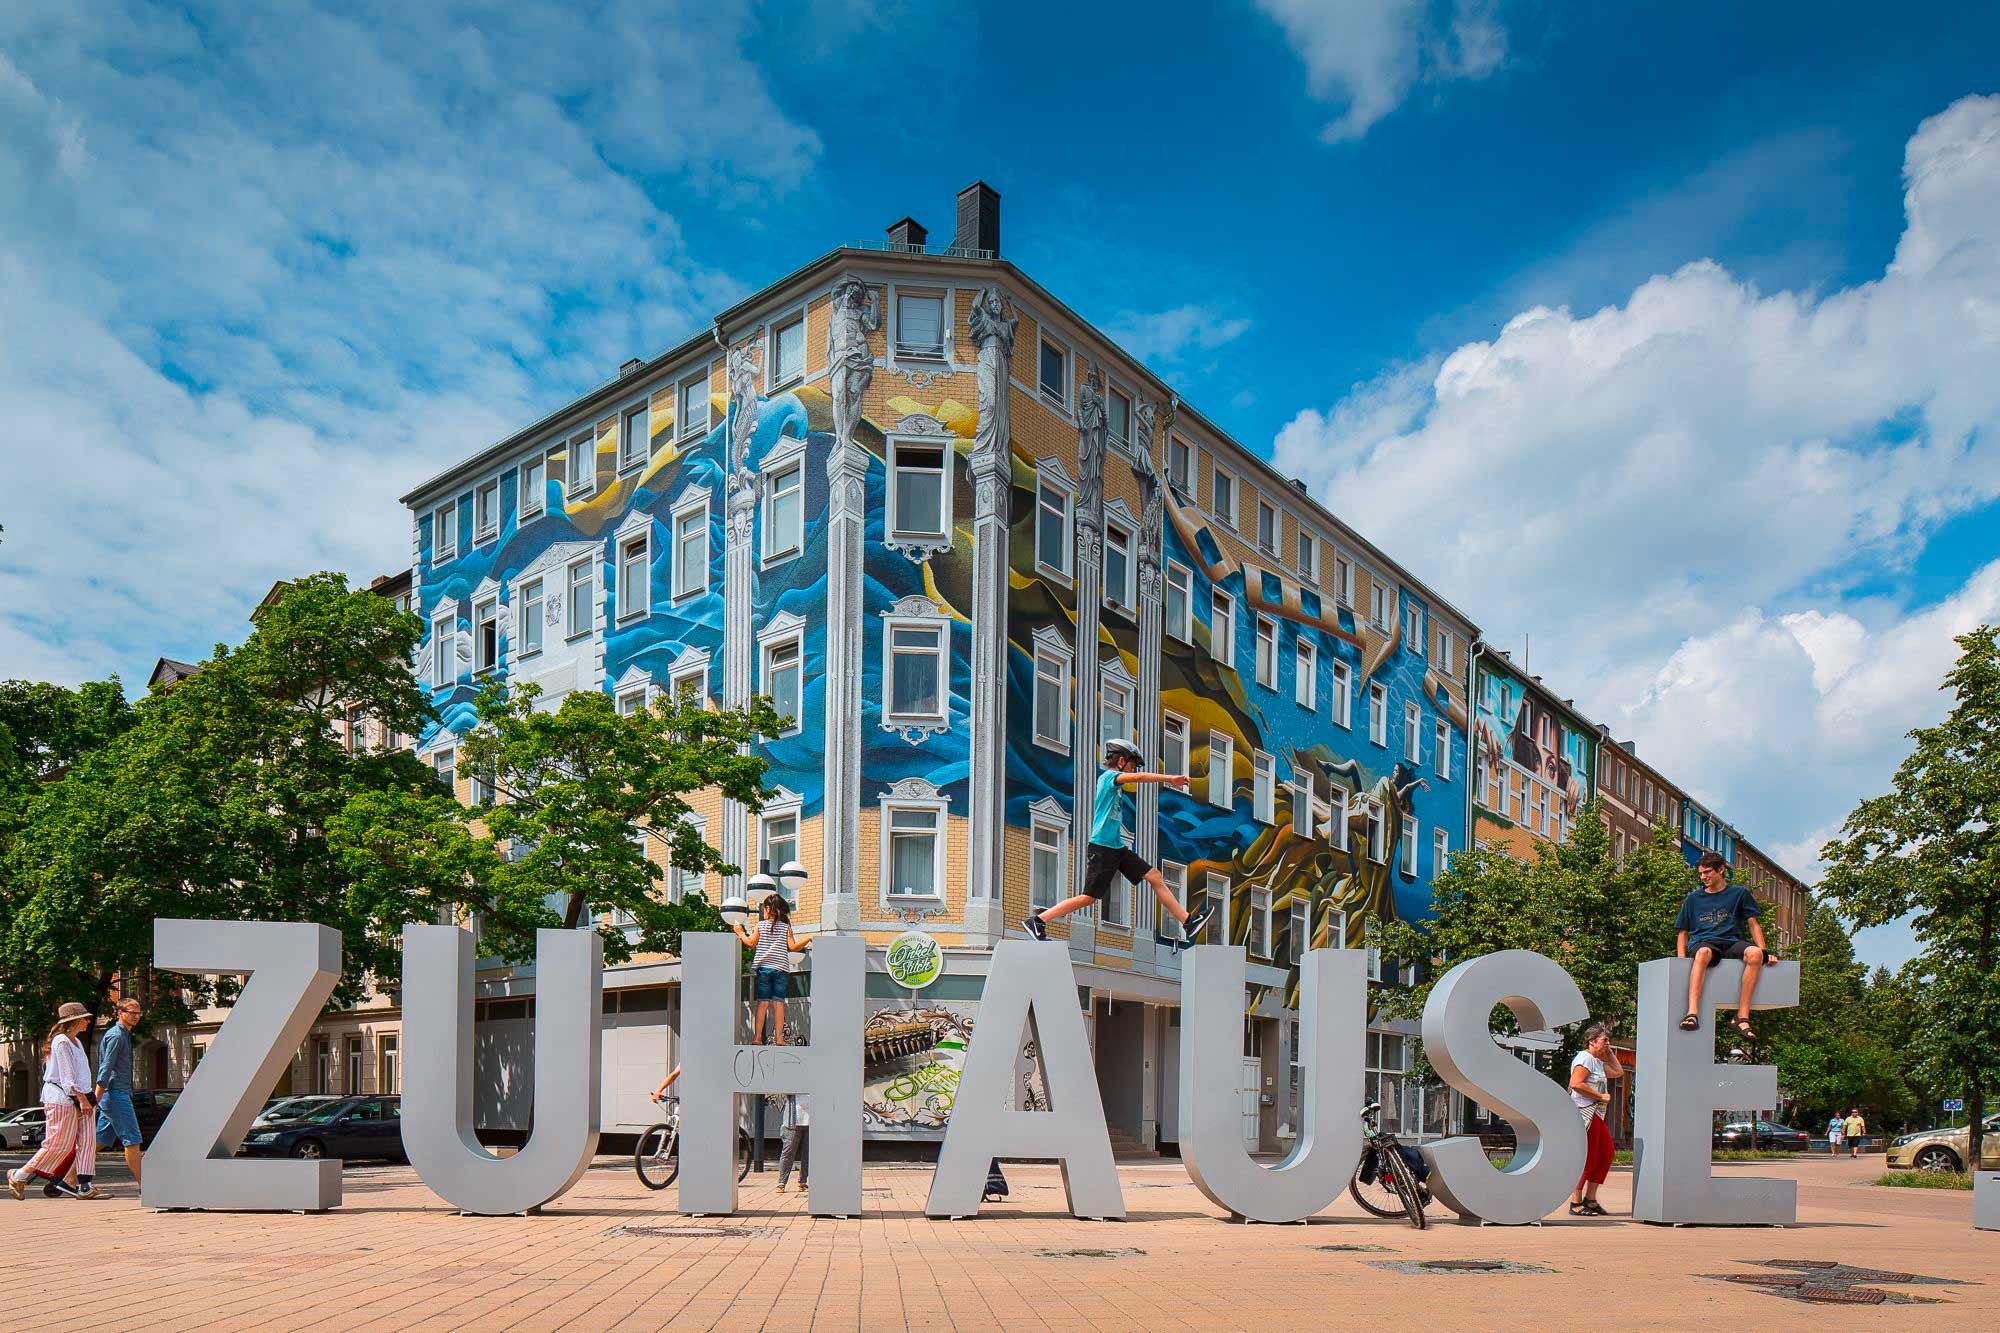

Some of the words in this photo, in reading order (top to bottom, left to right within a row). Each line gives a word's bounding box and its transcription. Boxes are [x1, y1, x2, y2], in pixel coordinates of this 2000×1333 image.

[887, 940, 937, 967] Onkel
[891, 956, 933, 981] Stitch
[141, 919, 1800, 1227] ZUHAUSE
